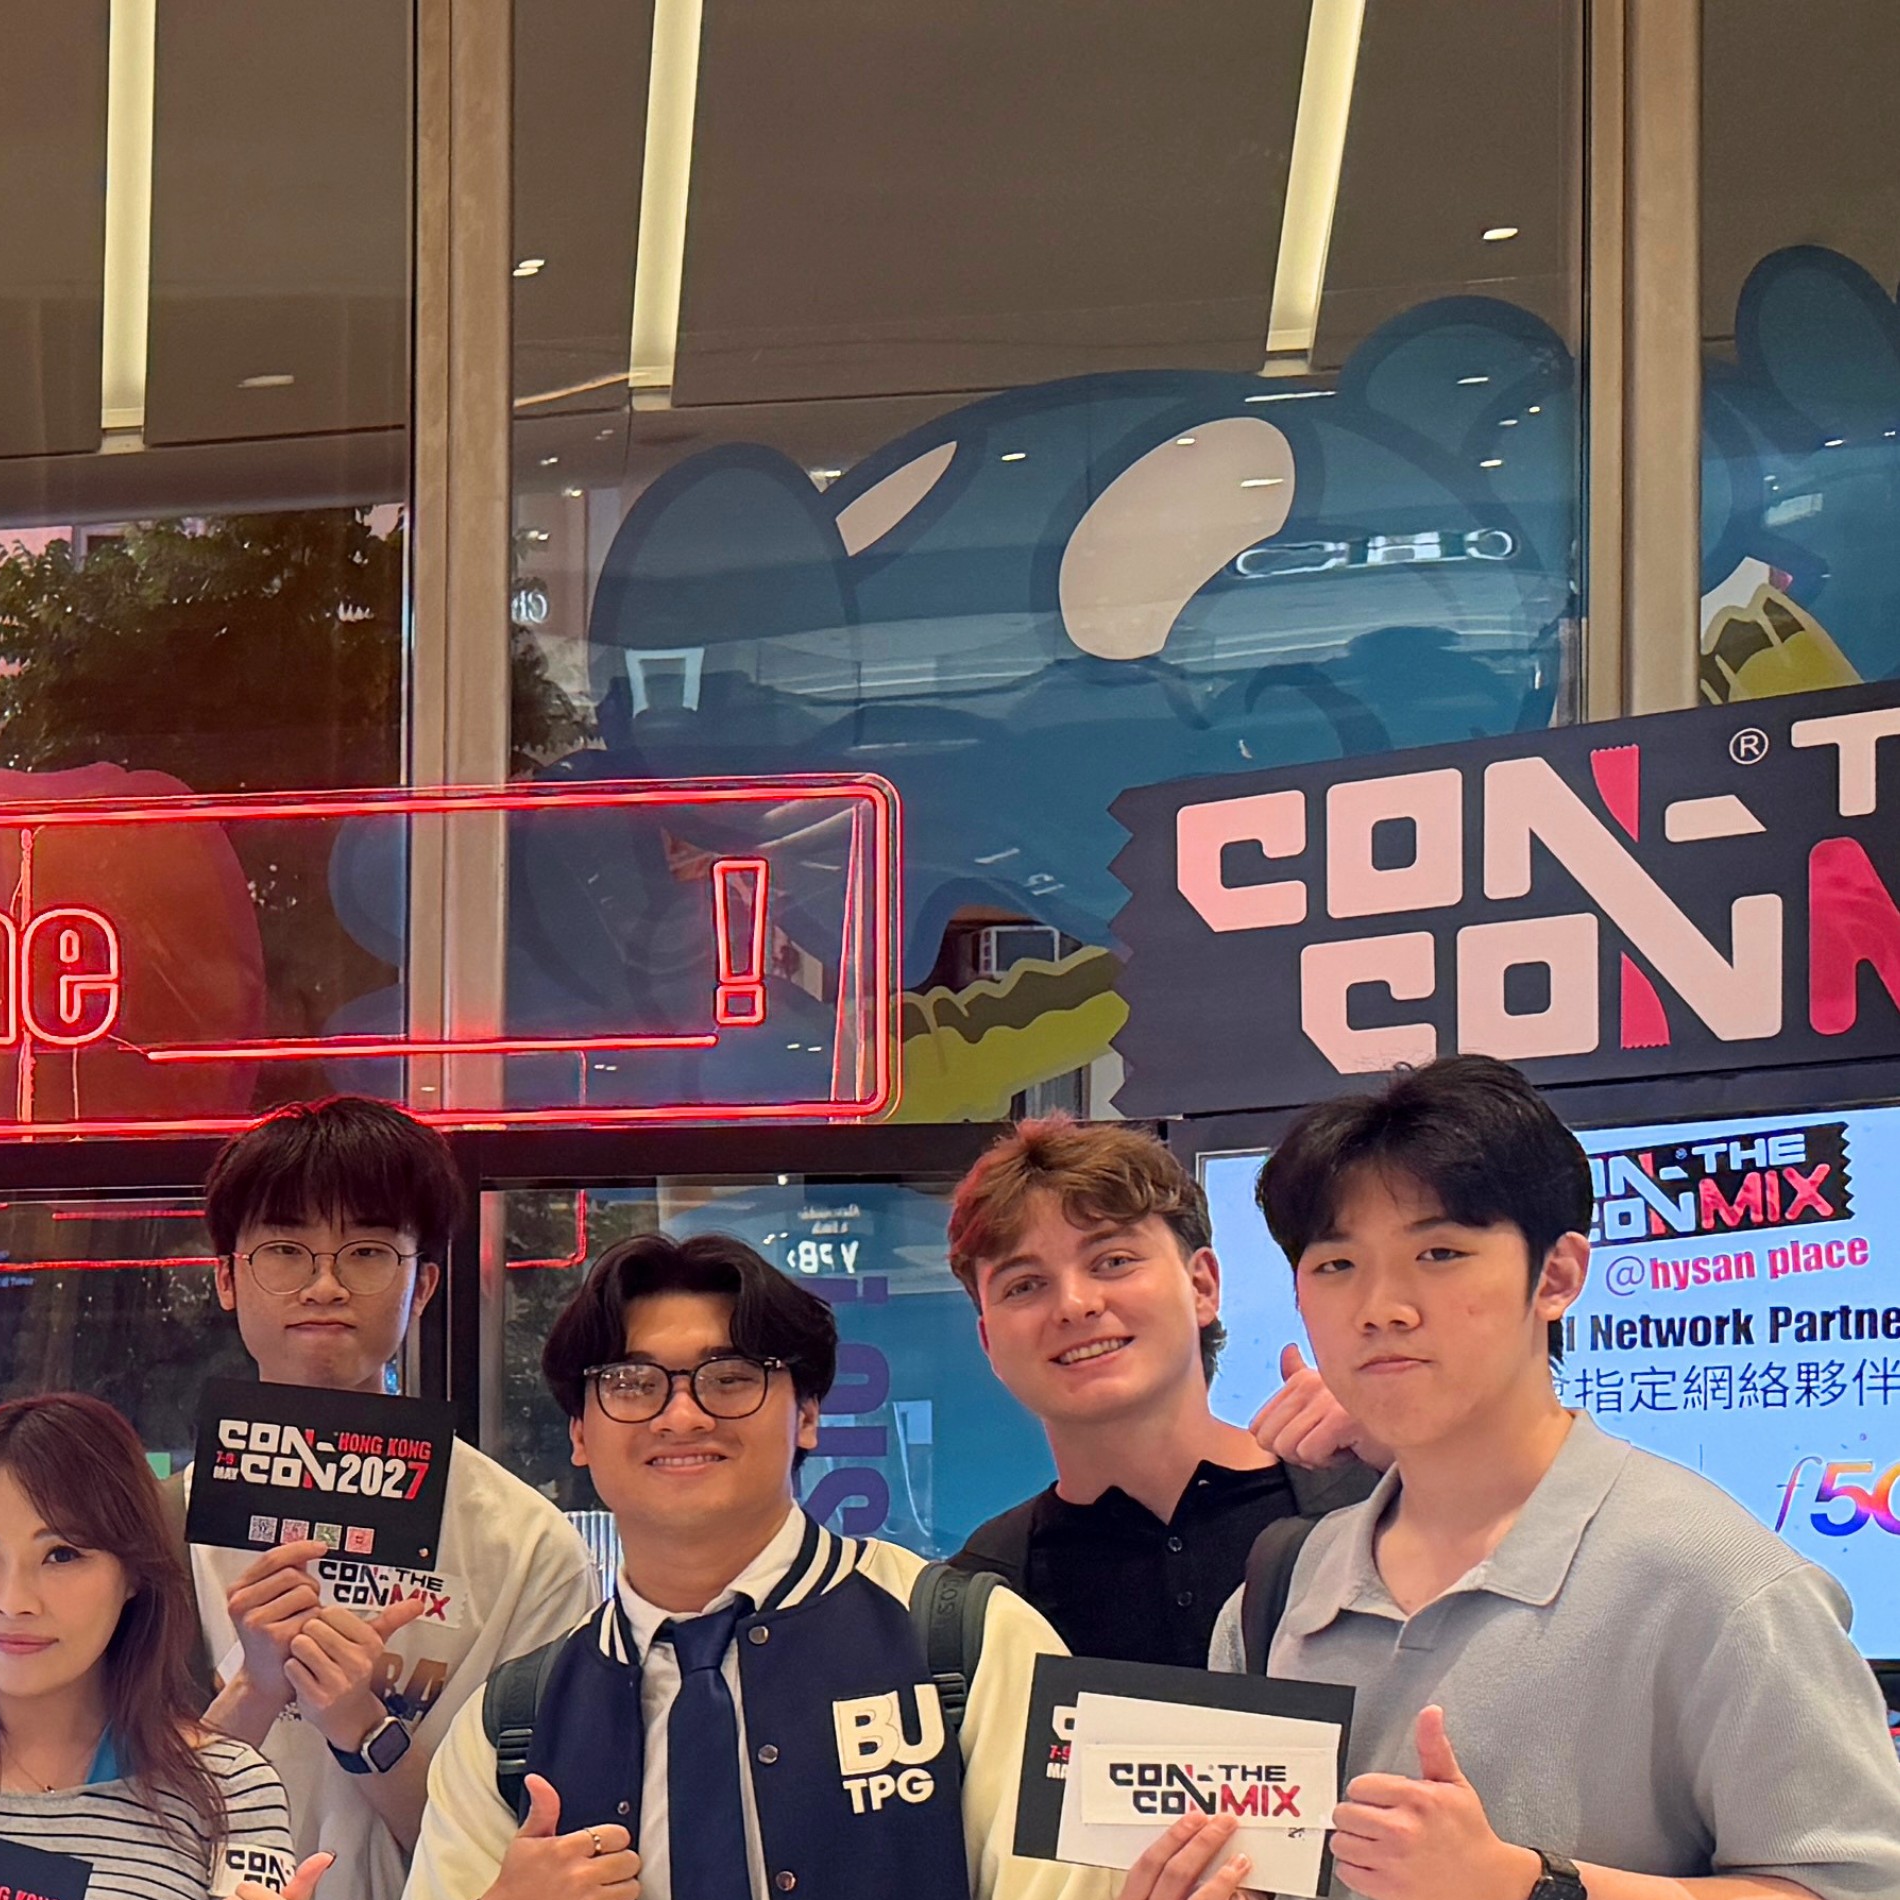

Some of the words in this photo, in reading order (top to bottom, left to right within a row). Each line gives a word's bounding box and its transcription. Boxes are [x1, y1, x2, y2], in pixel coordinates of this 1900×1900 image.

[1691, 1133, 1806, 1174] THE
[1699, 1163, 1834, 1230] MIX
[1768, 1236, 1869, 1280] place
[1590, 1307, 1755, 1352] Network
[1560, 1357, 1900, 1413] 指定網絡夥伴
[338, 1431, 383, 1456] HONG
[387, 1436, 432, 1460] KONG
[213, 1465, 239, 1481] MAY
[336, 1453, 429, 1500] 2027
[832, 1683, 945, 1776] BU
[842, 1768, 935, 1814] TPG
[1046, 1762, 1067, 1780] MA
